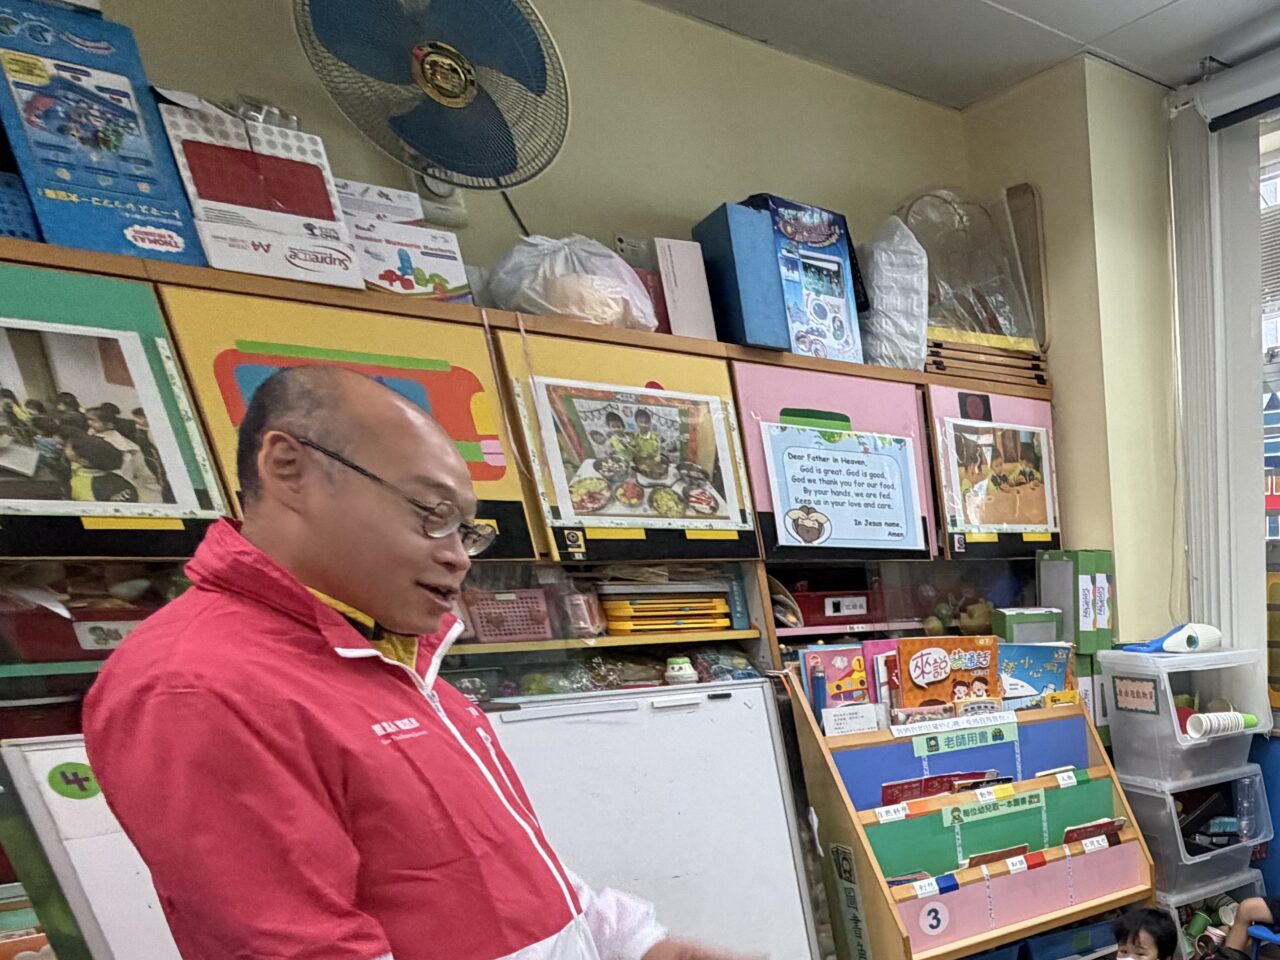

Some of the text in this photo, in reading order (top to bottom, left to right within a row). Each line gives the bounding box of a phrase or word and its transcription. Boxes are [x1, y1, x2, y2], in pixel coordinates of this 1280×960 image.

[250, 240, 271, 254] A4
[788, 452, 804, 461] Dear
[807, 455, 829, 463] Father
[800, 465, 814, 474] God
[846, 469, 859, 477] God
[792, 475, 805, 483] God
[819, 477, 838, 486] thank
[854, 480, 865, 488] for
[803, 487, 812, 496] By
[814, 489, 828, 497] your
[795, 497, 812, 506] Keep
[854, 519, 862, 527] In
[943, 730, 988, 749] 老師用書
[60, 770, 91, 792] 4
[926, 907, 942, 930] 3
